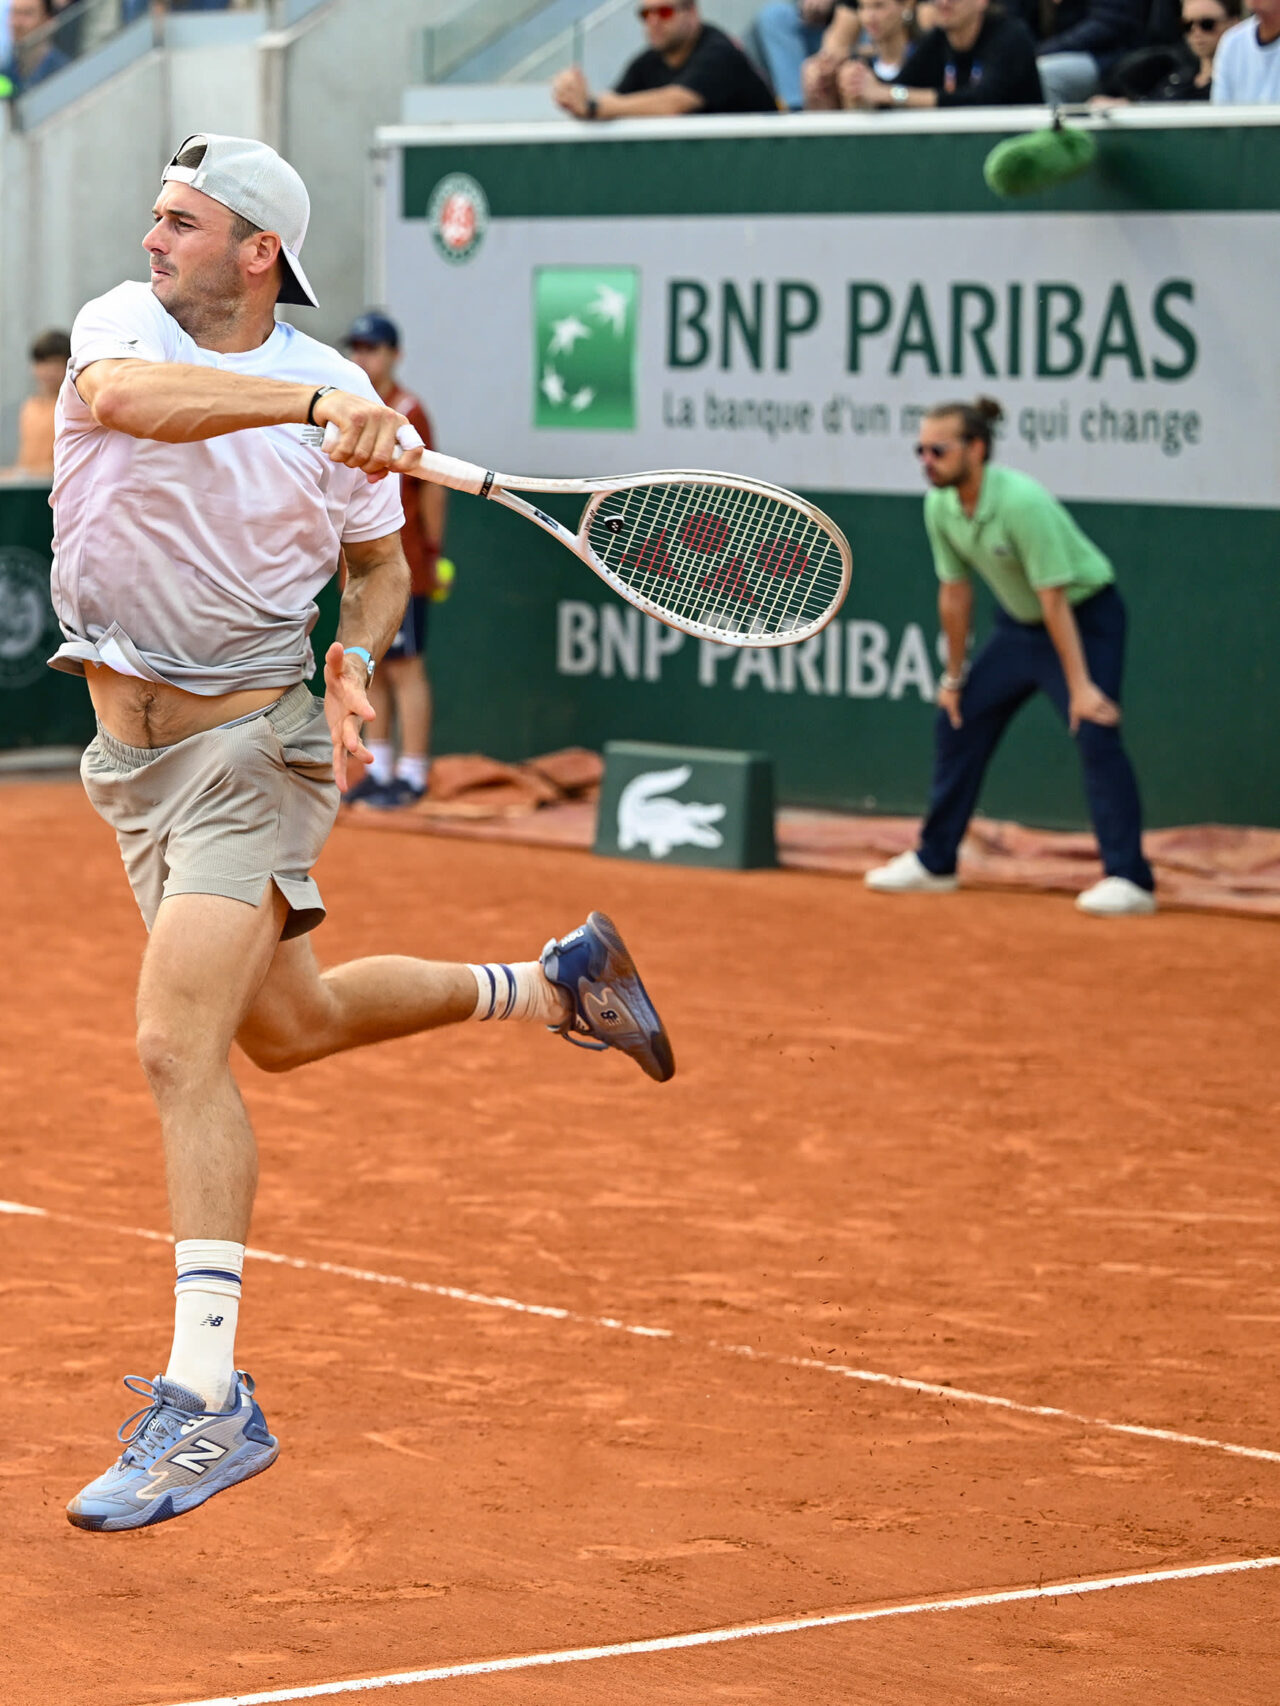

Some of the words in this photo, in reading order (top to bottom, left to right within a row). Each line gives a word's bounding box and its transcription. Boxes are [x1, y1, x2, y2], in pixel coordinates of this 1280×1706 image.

[667, 279, 822, 371] BNP
[847, 278, 1198, 381] PARIBAS
[663, 389, 695, 428] La
[705, 389, 814, 441] banque
[822, 394, 890, 434] d'un
[1018, 401, 1068, 447] qui
[1080, 401, 1200, 456] change
[557, 601, 683, 682] BNP
